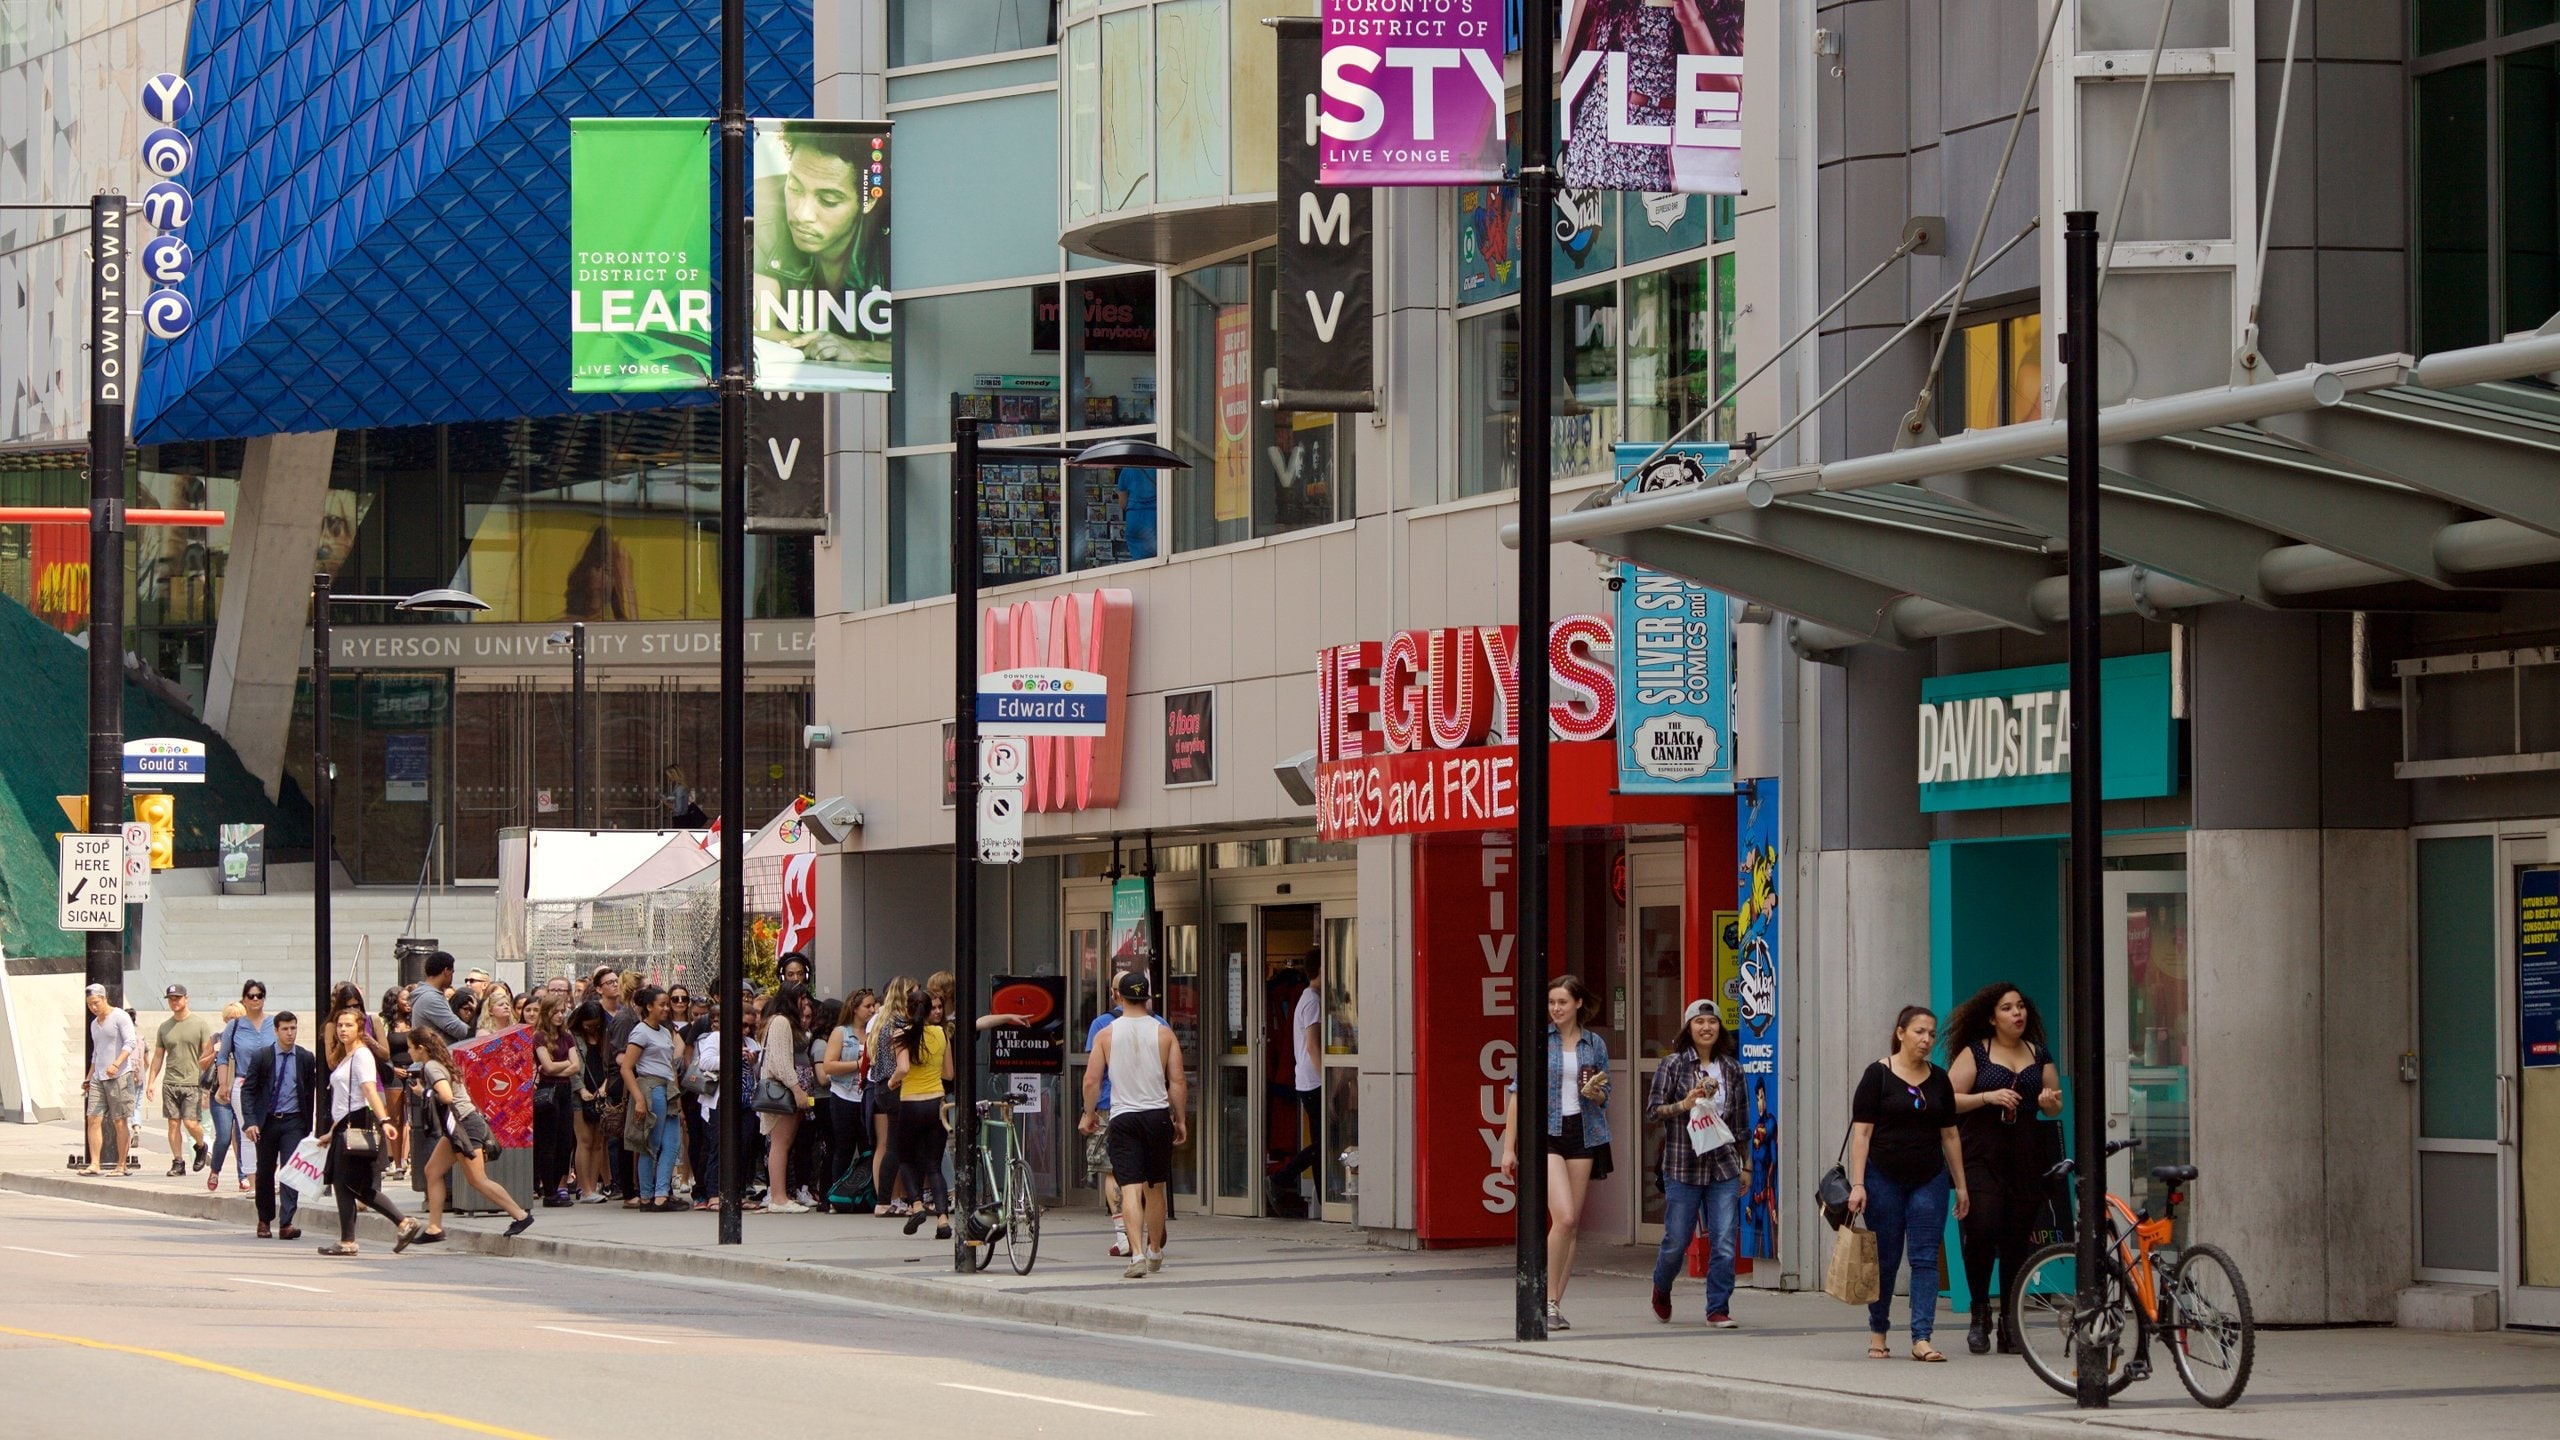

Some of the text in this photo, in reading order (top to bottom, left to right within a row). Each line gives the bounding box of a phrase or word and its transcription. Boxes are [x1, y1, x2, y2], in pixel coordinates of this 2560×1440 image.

[1331, 19, 1488, 37] DISTRICT OF
[1330, 150, 1450, 162] LIVE YONGE
[578, 251, 688, 265] TORONTO'S
[578, 268, 699, 282] DISTRICT OF
[101, 210, 120, 400] DOWNTOWN
[1040, 297, 1134, 323] mvies
[578, 364, 670, 375] LIVE YONGE
[1014, 378, 1051, 388] comedy
[1685, 592, 1707, 618] and
[342, 636, 461, 658] RYERSON
[475, 635, 628, 656] UNIVEITY
[641, 632, 763, 653] STUDET
[1636, 616, 1687, 706] SILVER
[1685, 621, 1709, 706] COMICS
[998, 697, 1086, 718] Edward St
[1168, 711, 1176, 737] 3
[1668, 721, 1682, 730] THE
[1654, 731, 1695, 746] BLACK
[1651, 745, 1700, 761] CANARY
[139, 757, 188, 772] Gould St
[1388, 760, 1436, 827] and
[1442, 756, 1518, 821] FRIE
[76, 841, 110, 854] STOP
[74, 859, 110, 871] HERE
[99, 876, 118, 888] ON
[90, 893, 117, 905] RED
[2544, 895, 2558, 906] SHOP
[67, 910, 116, 923] SIGNAL
[2523, 910, 2534, 920] AND
[2535, 909, 2549, 919] BEST
[1478, 847, 1516, 1017] FIVE
[2523, 934, 2531, 945] AS
[2531, 933, 2544, 944] BEST
[1740, 938, 1773, 996] Silver
[1740, 984, 1775, 1020] Snail
[996, 1030, 1018, 1040] PUT
[996, 1040, 1050, 1049] A RECORD
[1743, 1044, 1773, 1058] COMICS
[995, 1049, 1011, 1058] ON
[1751, 1060, 1773, 1074] CAFE
[1478, 1039, 1518, 1215] GUYS
[1691, 1114, 1714, 1132] hm
[289, 1151, 326, 1181] hmv
